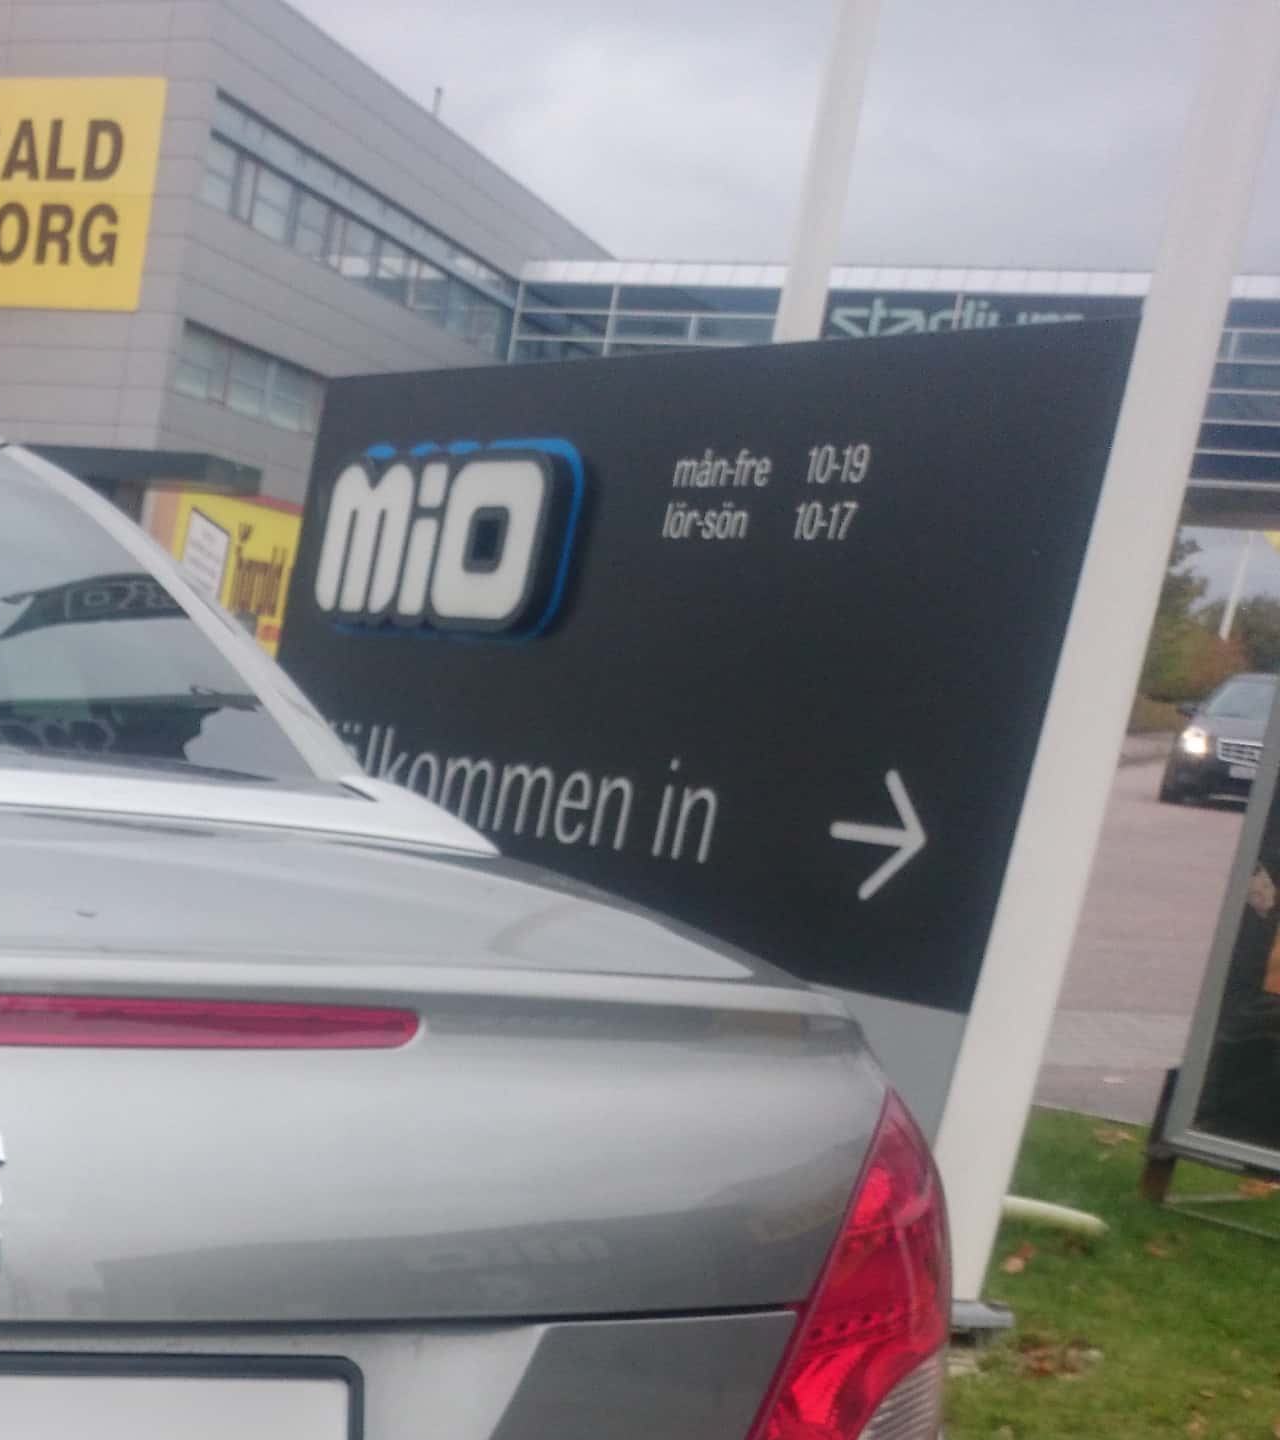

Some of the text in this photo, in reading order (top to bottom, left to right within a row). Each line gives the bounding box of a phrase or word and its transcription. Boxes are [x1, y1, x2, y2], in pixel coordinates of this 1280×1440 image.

[672, 443, 872, 488] mån-fre 10-19
[662, 500, 859, 541] lör-sön 10-17
[332, 722, 719, 864] lkommen in
